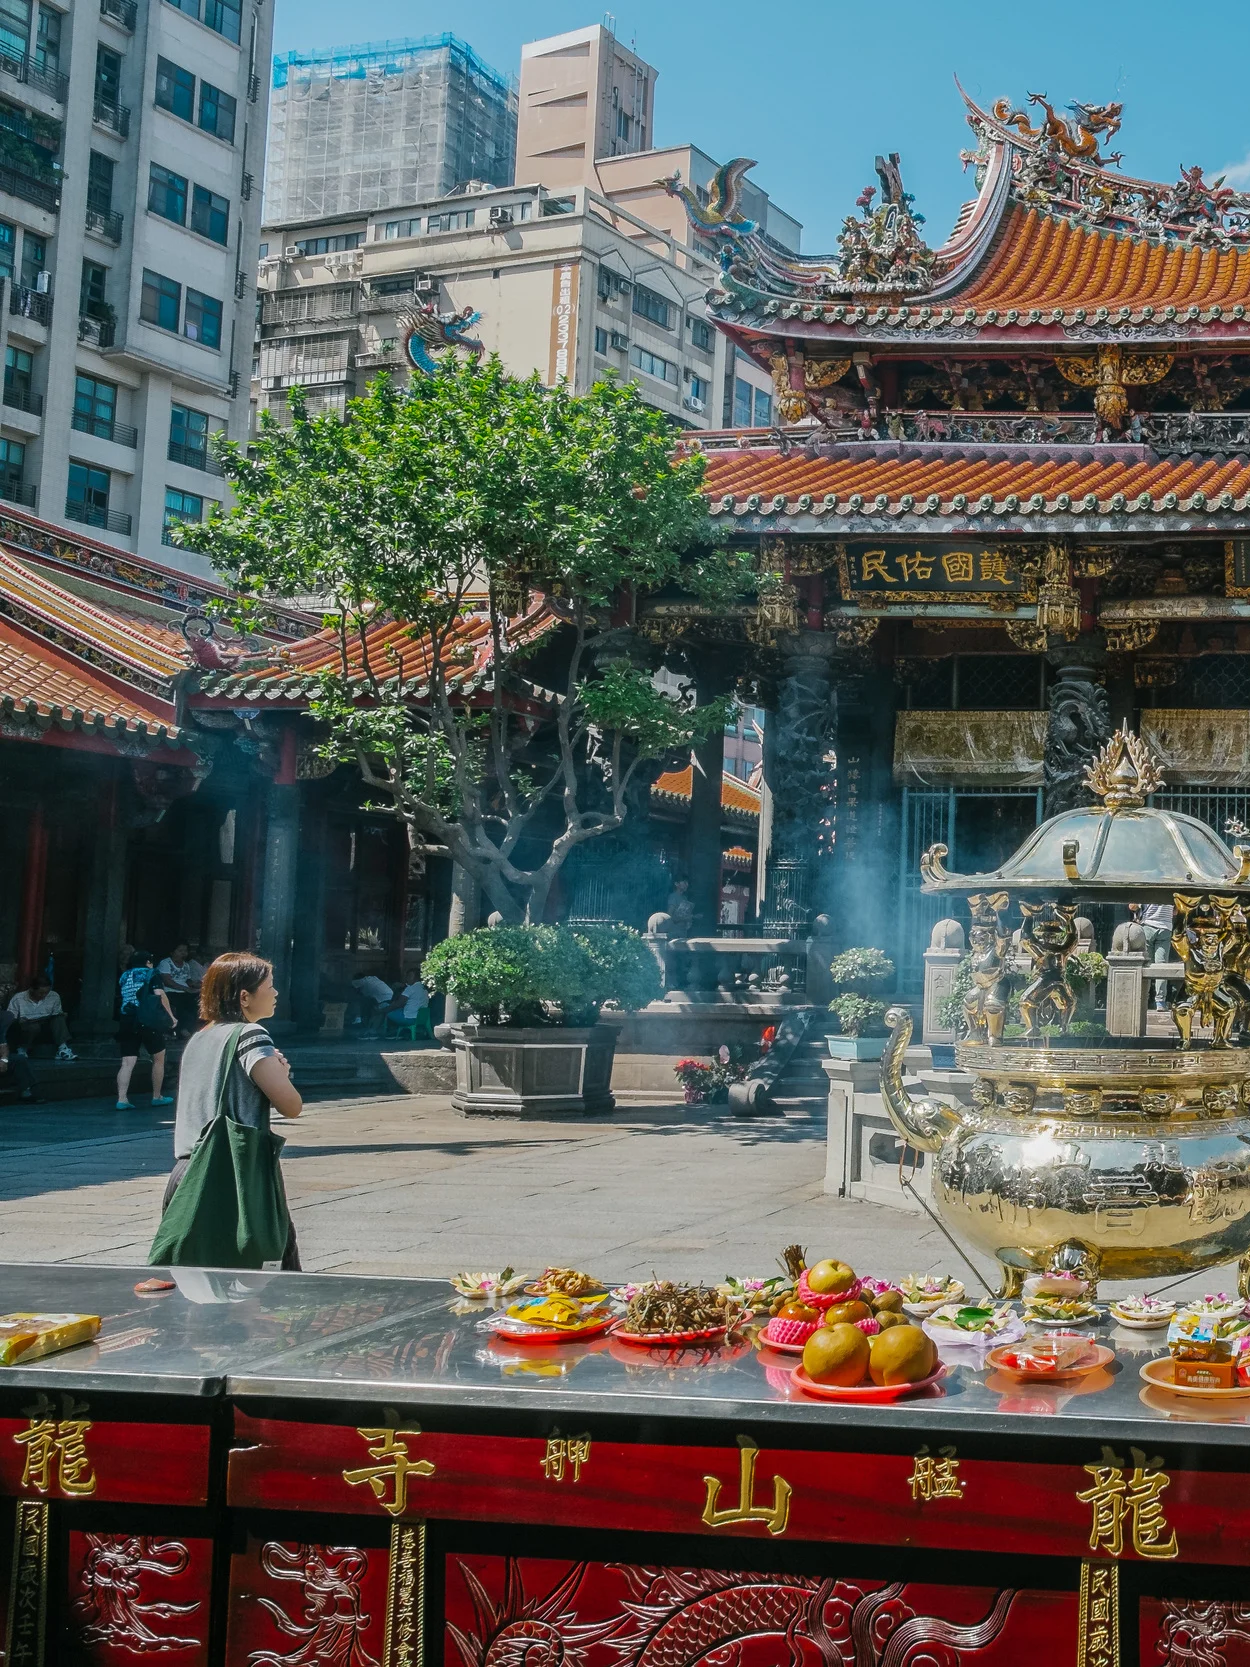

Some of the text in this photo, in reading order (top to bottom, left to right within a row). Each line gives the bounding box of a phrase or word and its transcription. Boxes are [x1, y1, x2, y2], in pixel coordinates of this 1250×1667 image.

[12, 1393, 98, 1497] 龍
[343, 1408, 1179, 1559] 龍 艋 山 舺 寺
